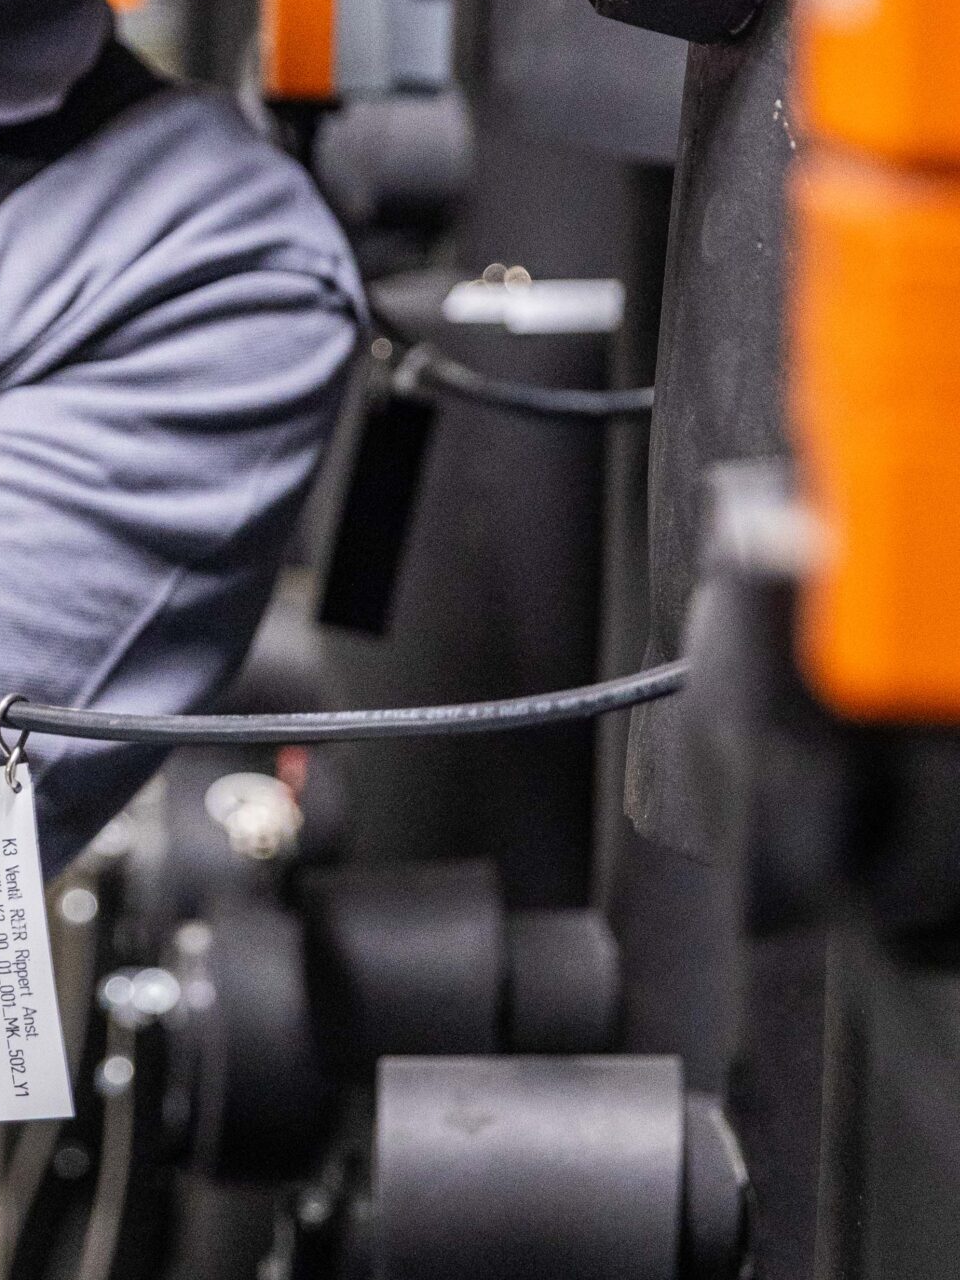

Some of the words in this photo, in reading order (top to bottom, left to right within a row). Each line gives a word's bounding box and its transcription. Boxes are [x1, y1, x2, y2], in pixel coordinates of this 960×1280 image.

[2, 838, 18, 857] K3
[5, 865, 23, 901] Ventil
[14, 949, 34, 998] Rippert
[22, 1006, 39, 1041] Anst.
